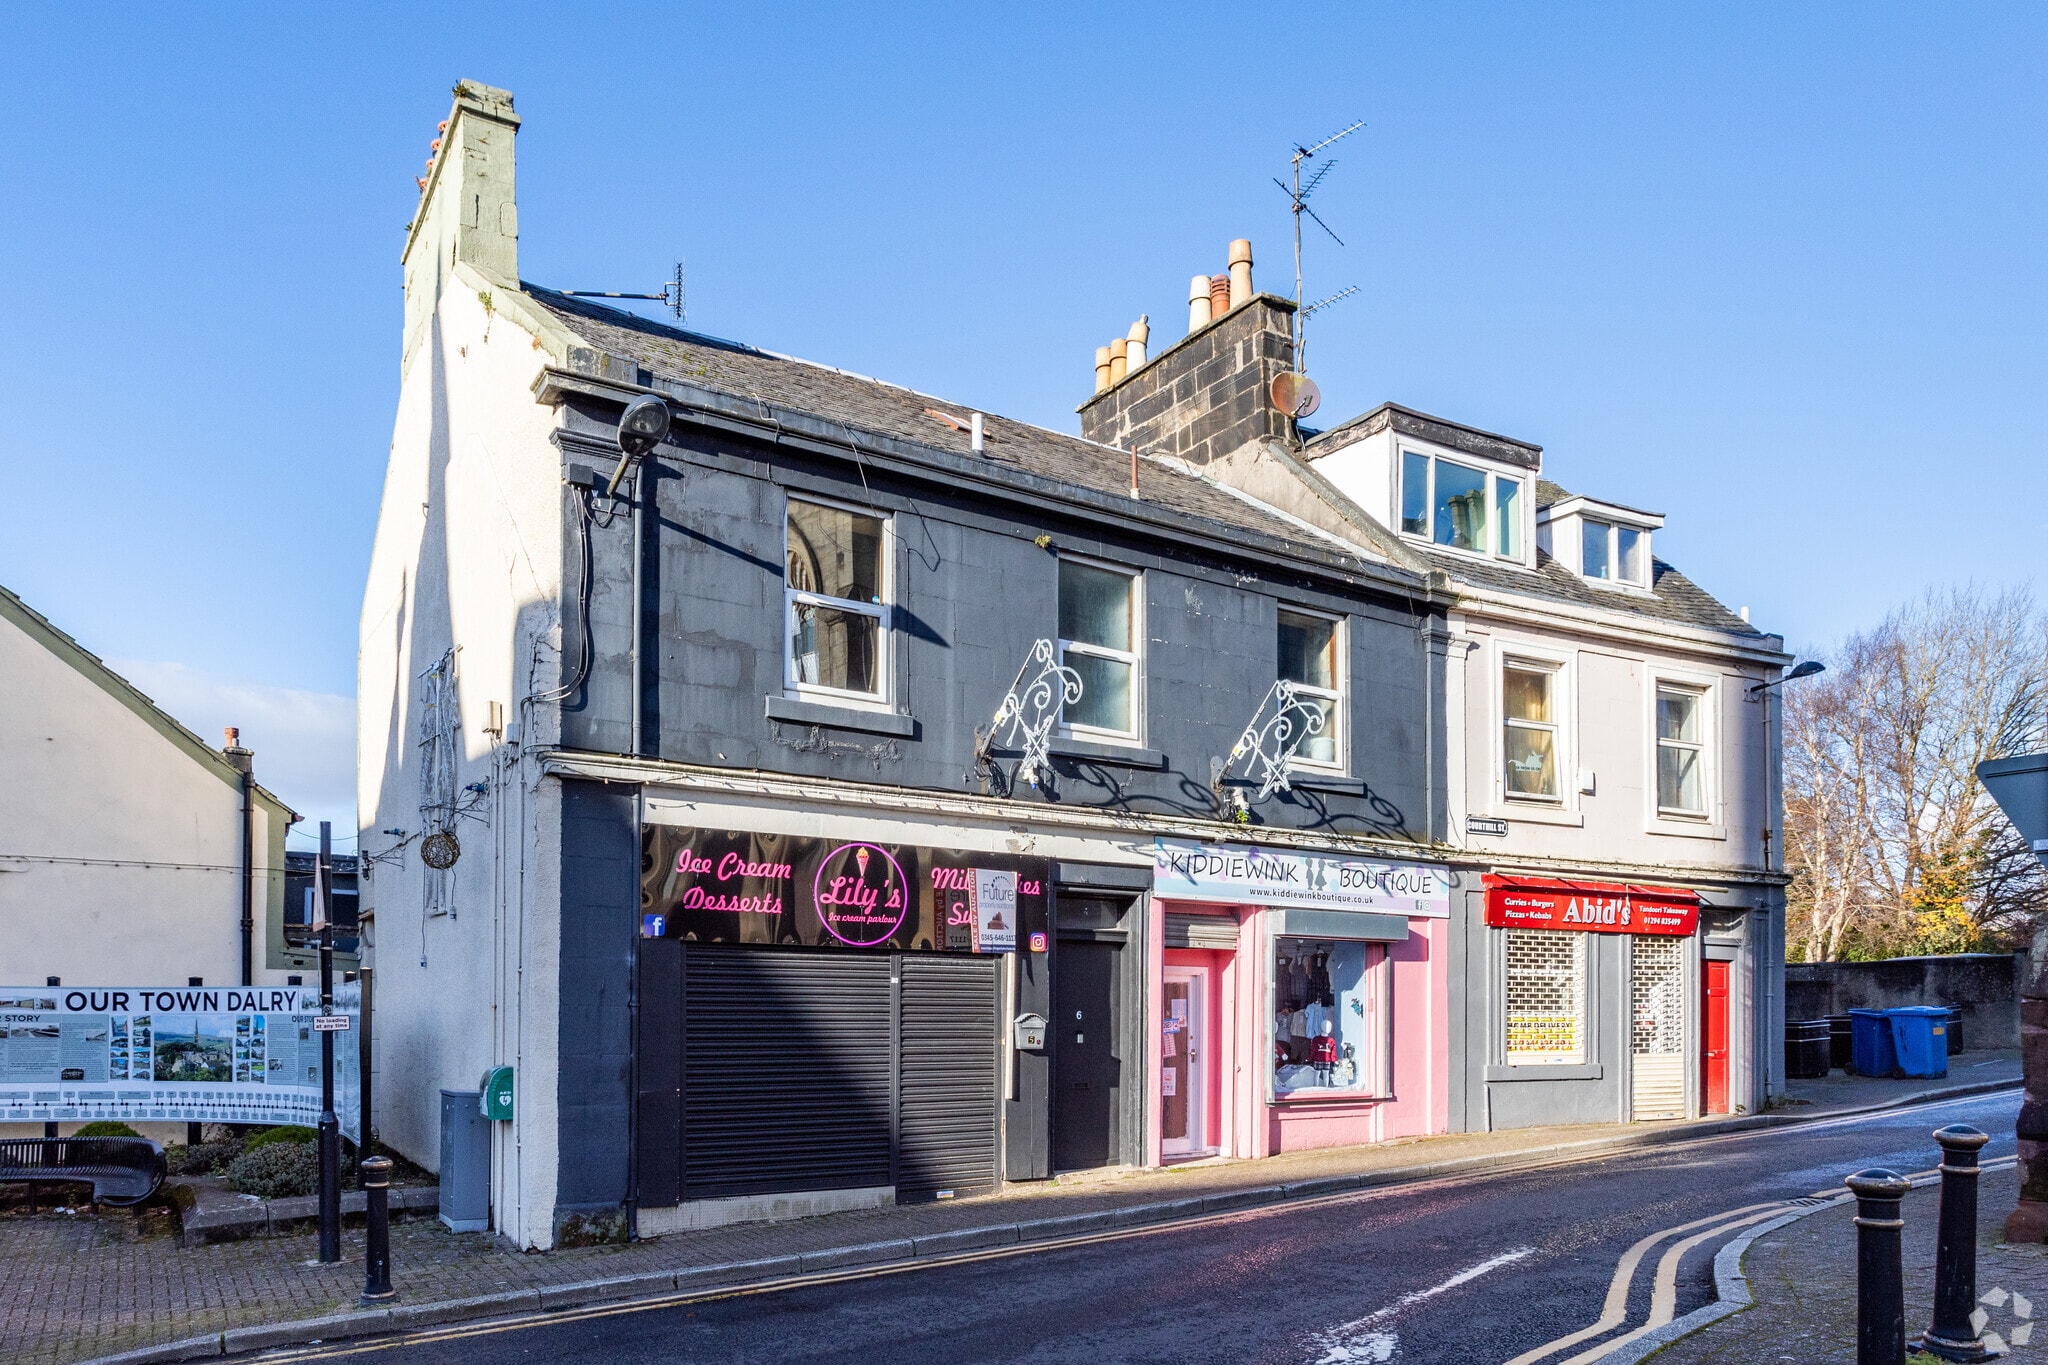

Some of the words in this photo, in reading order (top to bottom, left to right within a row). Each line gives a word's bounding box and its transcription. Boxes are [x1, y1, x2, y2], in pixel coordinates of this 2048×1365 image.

[675, 848, 712, 873] Ice
[717, 852, 792, 881] Cream
[1170, 852, 1298, 882] KIDDIEWINK
[1340, 868, 1432, 894] BOUTIQUE
[820, 876, 901, 915] Lily's
[969, 870, 977, 913] AUCTION
[983, 883, 1014, 901] Future
[1249, 888, 1374, 905] www.kiddiewinkboutique.co.uk
[683, 886, 782, 914] Desserts
[1505, 898, 1527, 906] Curries
[1531, 899, 1554, 909] Burgers
[1505, 910, 1526, 918] Pizzas
[1529, 911, 1553, 920] Kebabs
[1562, 897, 1630, 925] Abid's
[1639, 905, 1662, 913] Tandoori
[1663, 906, 1689, 916] Takeaway
[828, 912, 841, 922] Ice
[842, 914, 866, 922] cream
[867, 914, 897, 925] parlour
[972, 914, 978, 926] BY
[1644, 917, 1660, 925] 01294
[66, 991, 130, 1012] OUR
[139, 991, 218, 1012] TOWN
[227, 991, 297, 1012] DALRY
[5, 1014, 40, 1022] STORY
[1075, 1010, 1082, 1020] 6
[1028, 1036, 1035, 1044] 5
